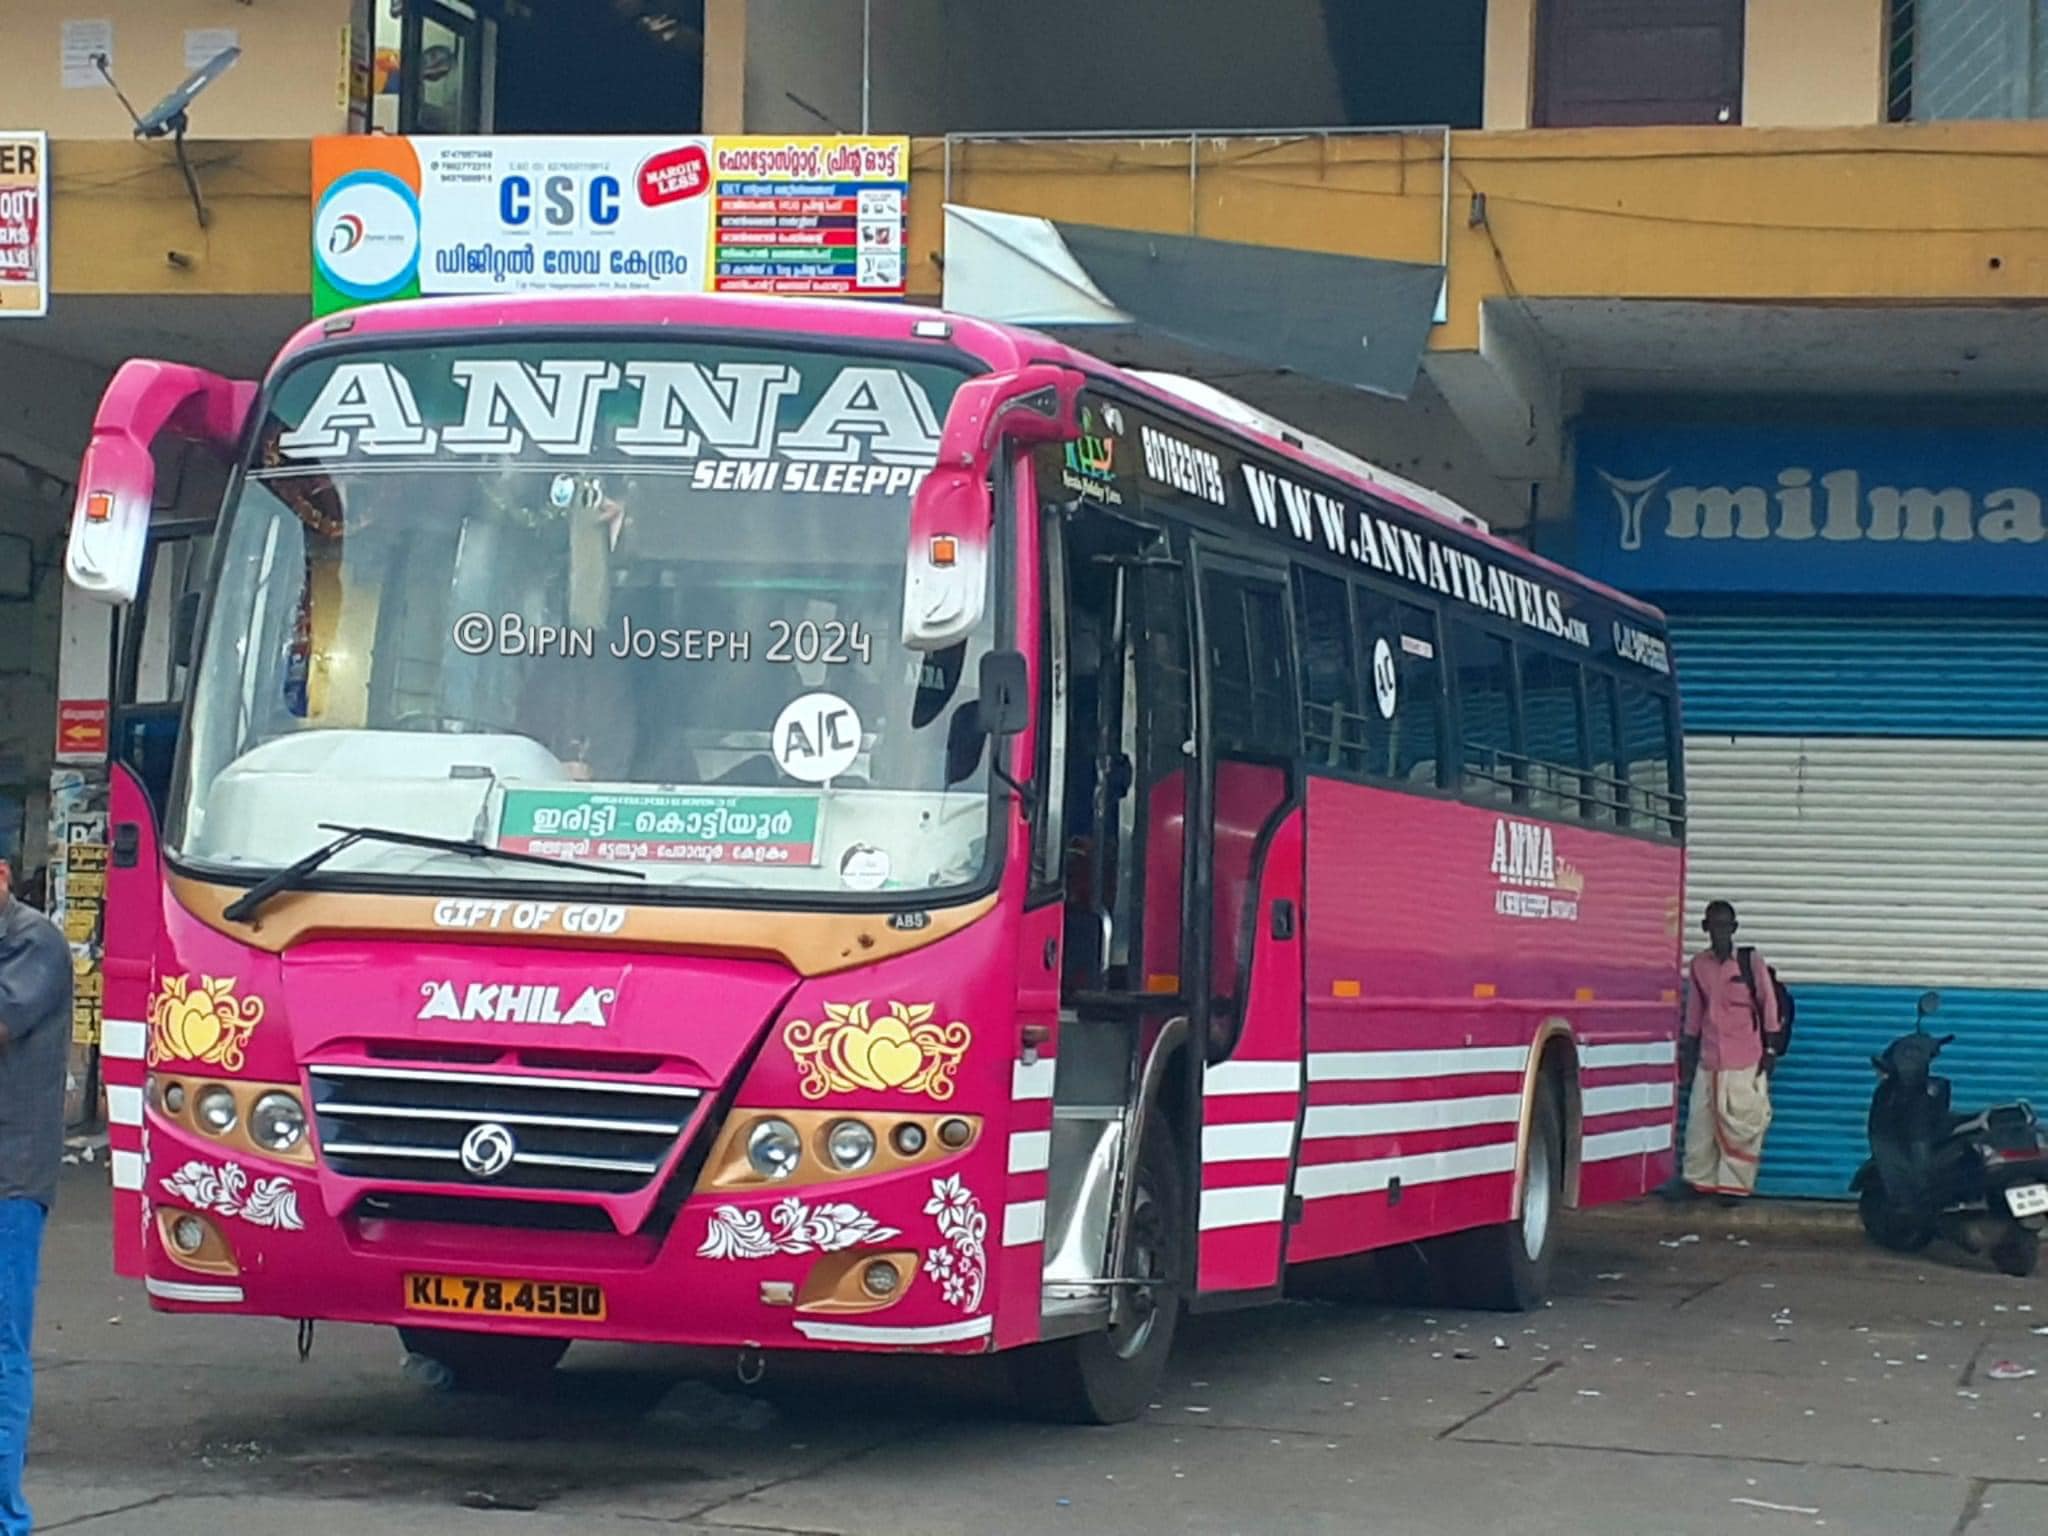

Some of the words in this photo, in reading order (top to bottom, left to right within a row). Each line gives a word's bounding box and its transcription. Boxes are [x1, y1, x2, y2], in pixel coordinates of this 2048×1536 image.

[658, 172, 700, 195] LESS
[435, 243, 535, 283] ഡിജിറ്റൽ
[543, 250, 600, 275] സേവ
[609, 250, 688, 281] കേന്ദ്രം
[279, 360, 942, 459] ANNA
[691, 459, 781, 492] SEMI
[1665, 468, 2048, 543] milma
[781, 709, 855, 764] A/C
[532, 804, 617, 837] ഇരിട്ടി
[635, 807, 793, 839] കൊട്ടിയൂർ
[433, 897, 512, 929] GIFT
[512, 900, 560, 929] OF
[561, 902, 626, 934] GOD
[895, 911, 924, 928] ABS
[417, 980, 616, 1027] AKHILA
